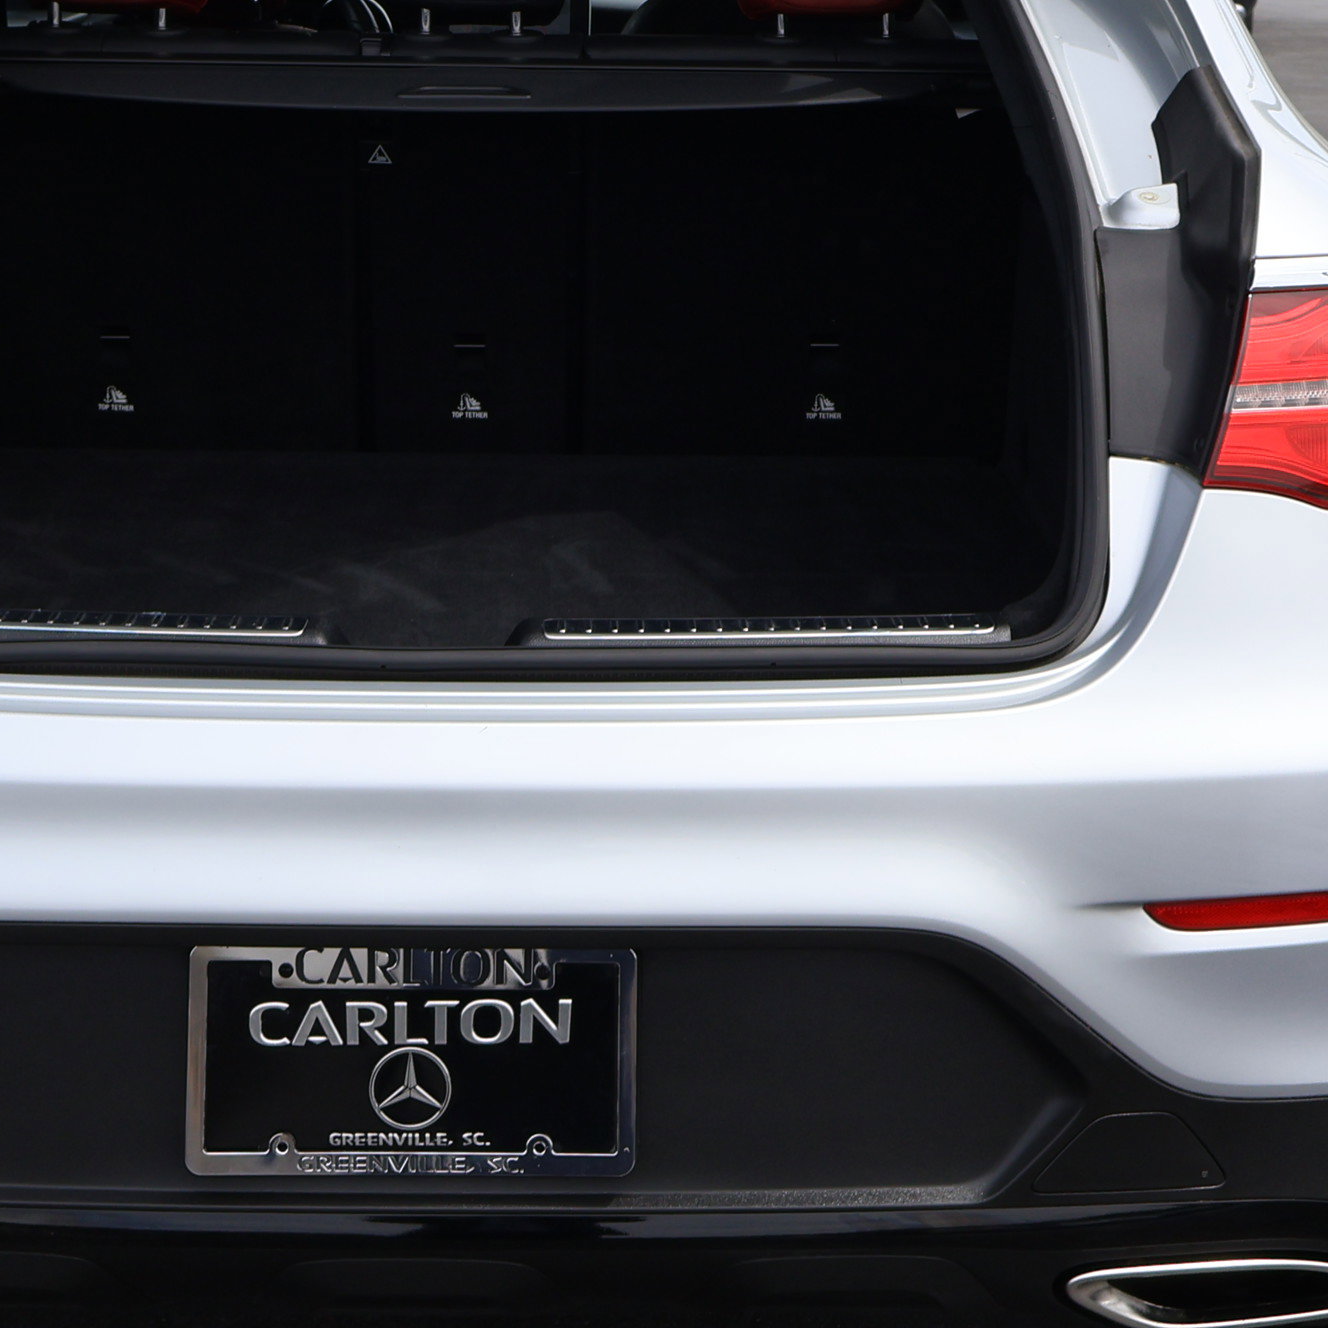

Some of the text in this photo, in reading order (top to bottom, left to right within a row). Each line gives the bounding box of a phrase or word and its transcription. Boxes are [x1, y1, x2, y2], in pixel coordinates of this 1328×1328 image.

[98, 403, 110, 411] TOP
[452, 411, 488, 419] TOP TETHER
[806, 412, 842, 420] TOP TETHER
[294, 947, 534, 987] CARLTON
[248, 997, 573, 1047] CARLTON
[462, 1132, 492, 1147] SC.
[486, 1156, 525, 1174] SC.
